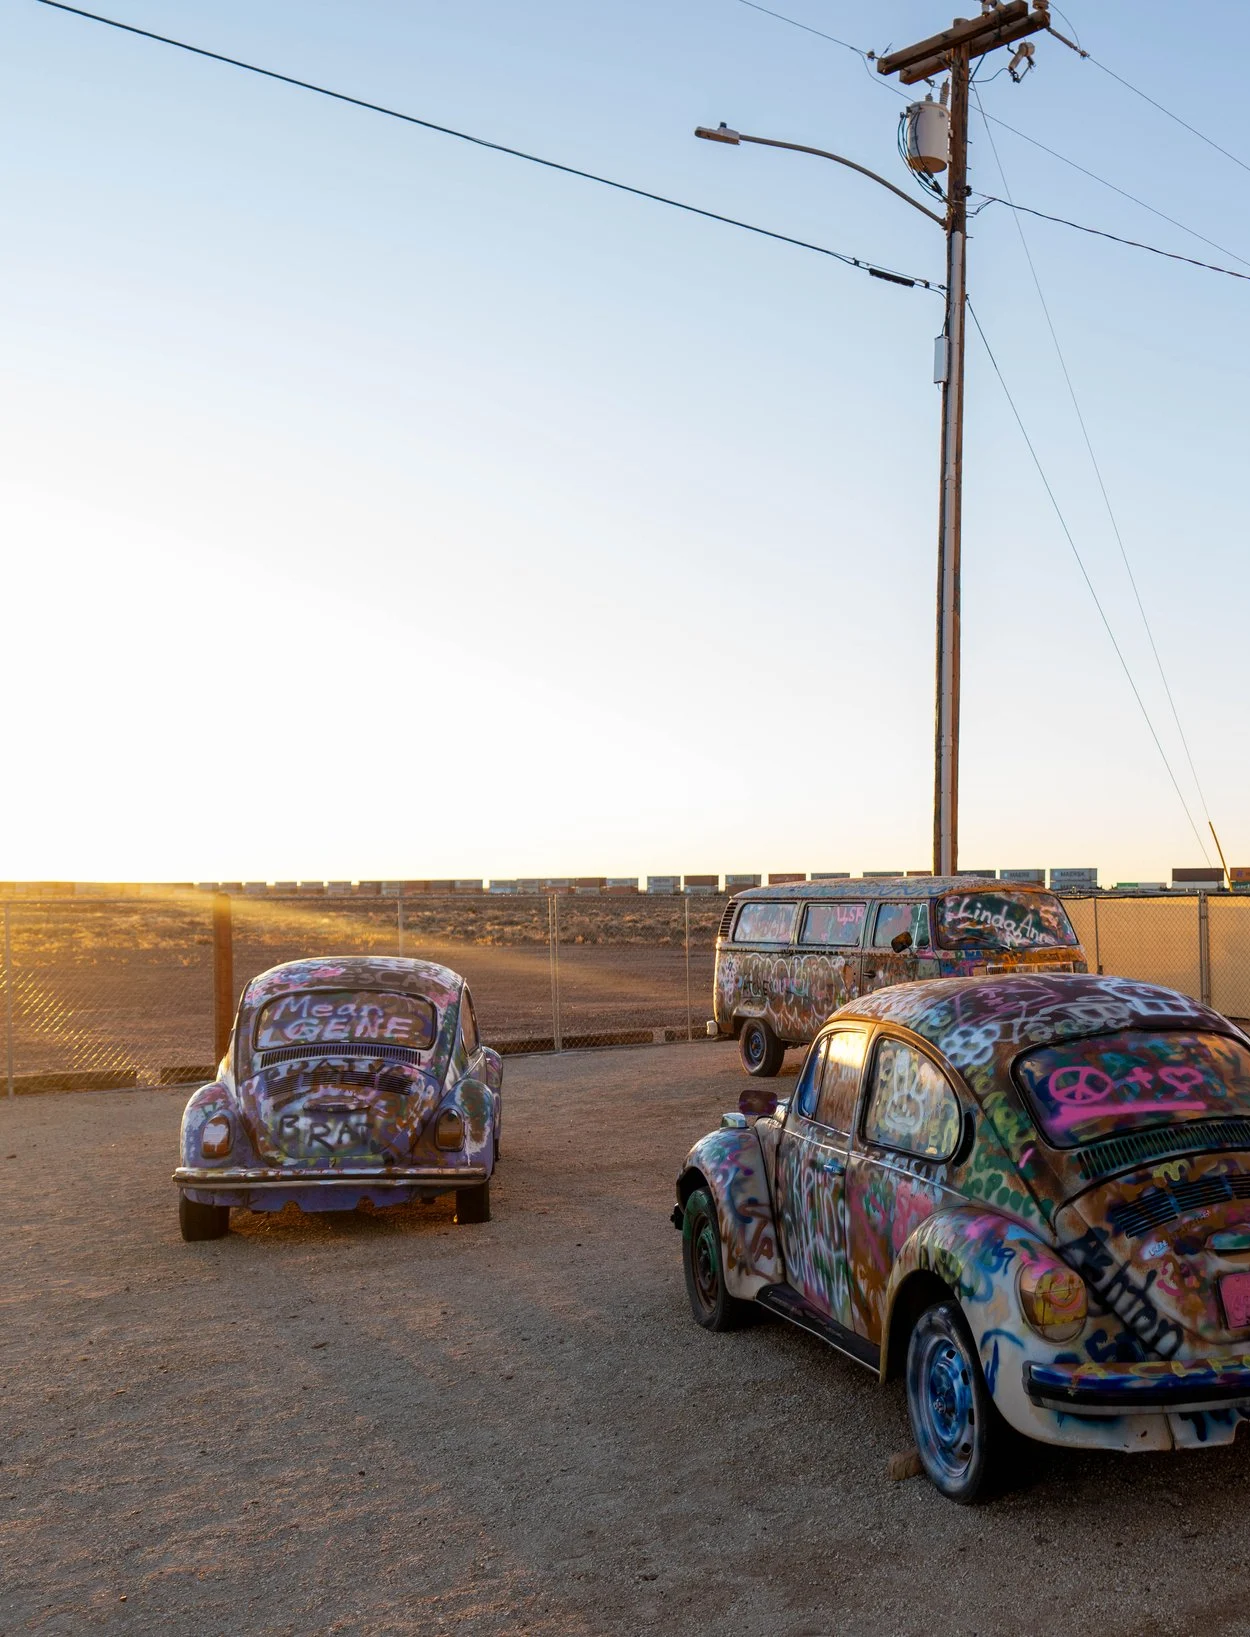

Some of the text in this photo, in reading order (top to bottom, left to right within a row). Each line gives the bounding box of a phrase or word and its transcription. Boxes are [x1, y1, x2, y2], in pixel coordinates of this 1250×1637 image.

[958, 897, 1016, 930] Linda
[273, 994, 384, 1020] Mean
[286, 1016, 413, 1041] GENE
[279, 1113, 374, 1153] BRAT
